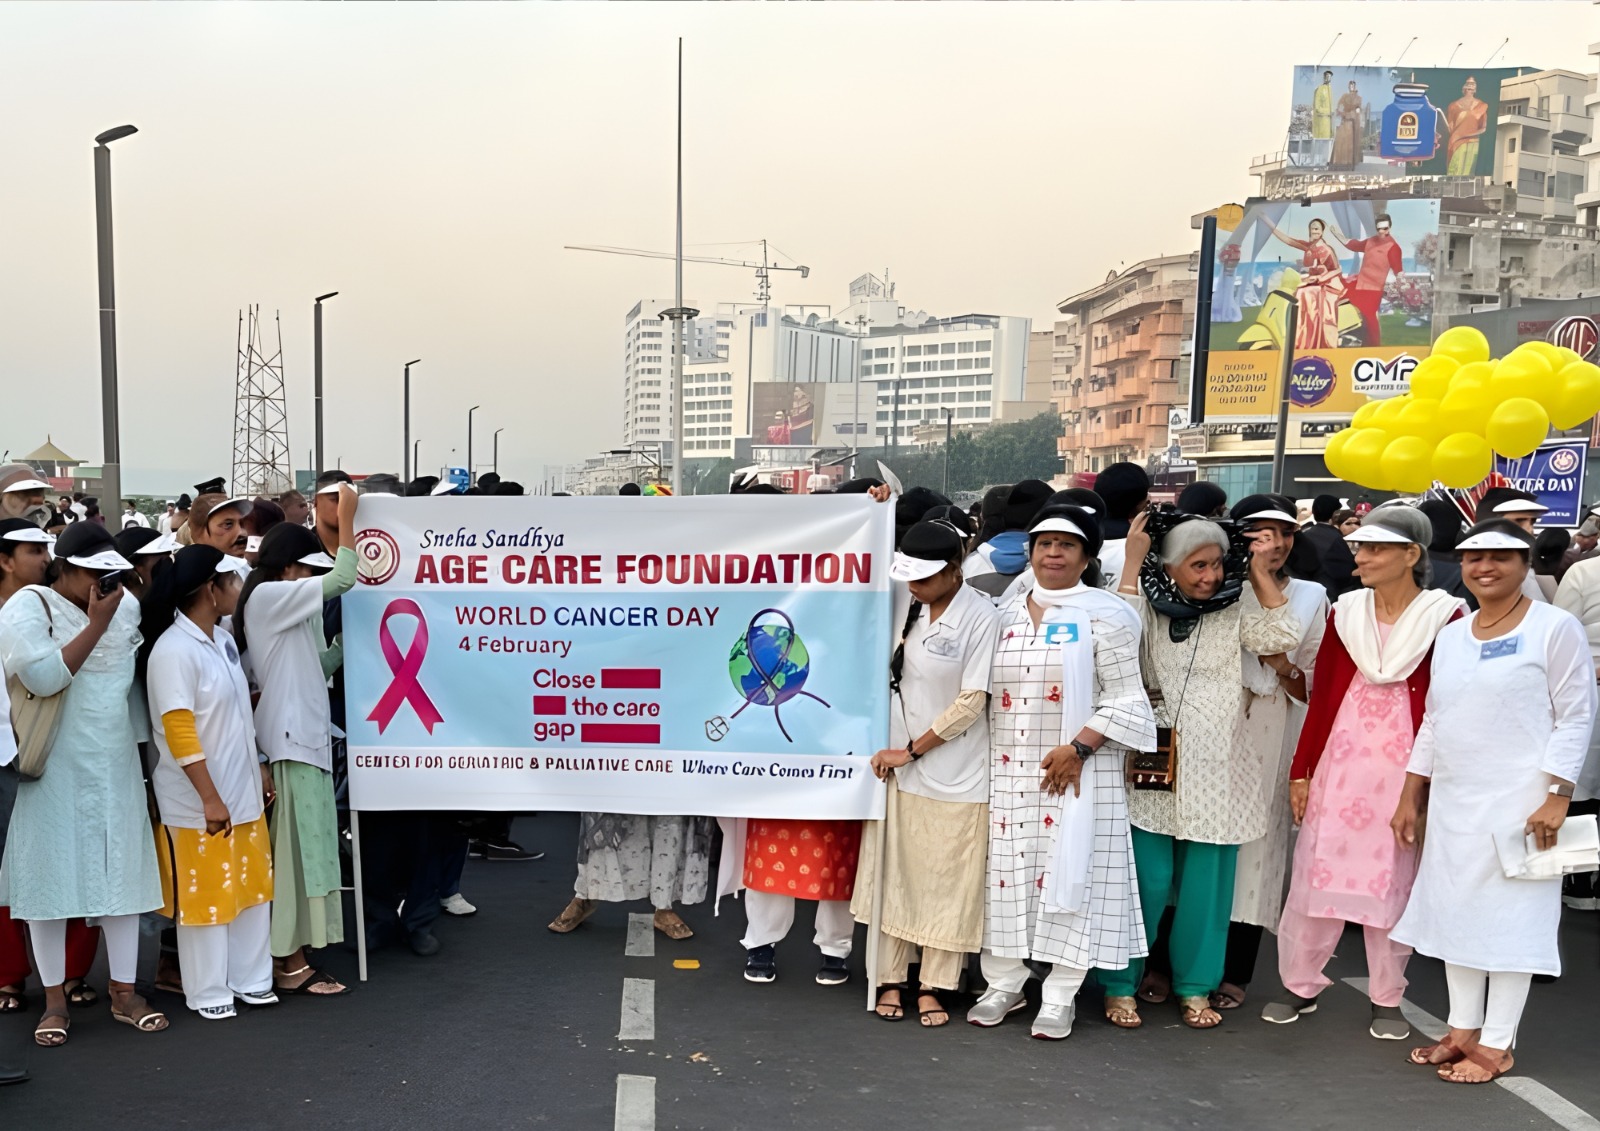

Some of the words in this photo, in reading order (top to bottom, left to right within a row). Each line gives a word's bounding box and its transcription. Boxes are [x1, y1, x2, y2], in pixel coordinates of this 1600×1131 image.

[1547, 478, 1577, 492] DAY
[420, 527, 477, 548] Sneha
[482, 526, 564, 554] Sandhya
[414, 554, 489, 584] AGE
[502, 554, 602, 585] CARE
[617, 553, 871, 585] FOUNDATION
[455, 606, 547, 626] WORLD
[553, 606, 658, 627] CANCER
[667, 606, 720, 627] DAY
[458, 636, 472, 652] 4
[478, 636, 572, 658] February
[533, 668, 596, 689] Close
[572, 697, 608, 716] the
[533, 721, 576, 742] gap
[545, 757, 630, 772] PALLIATIVE
[634, 759, 674, 774] CARE
[682, 759, 729, 776] Where
